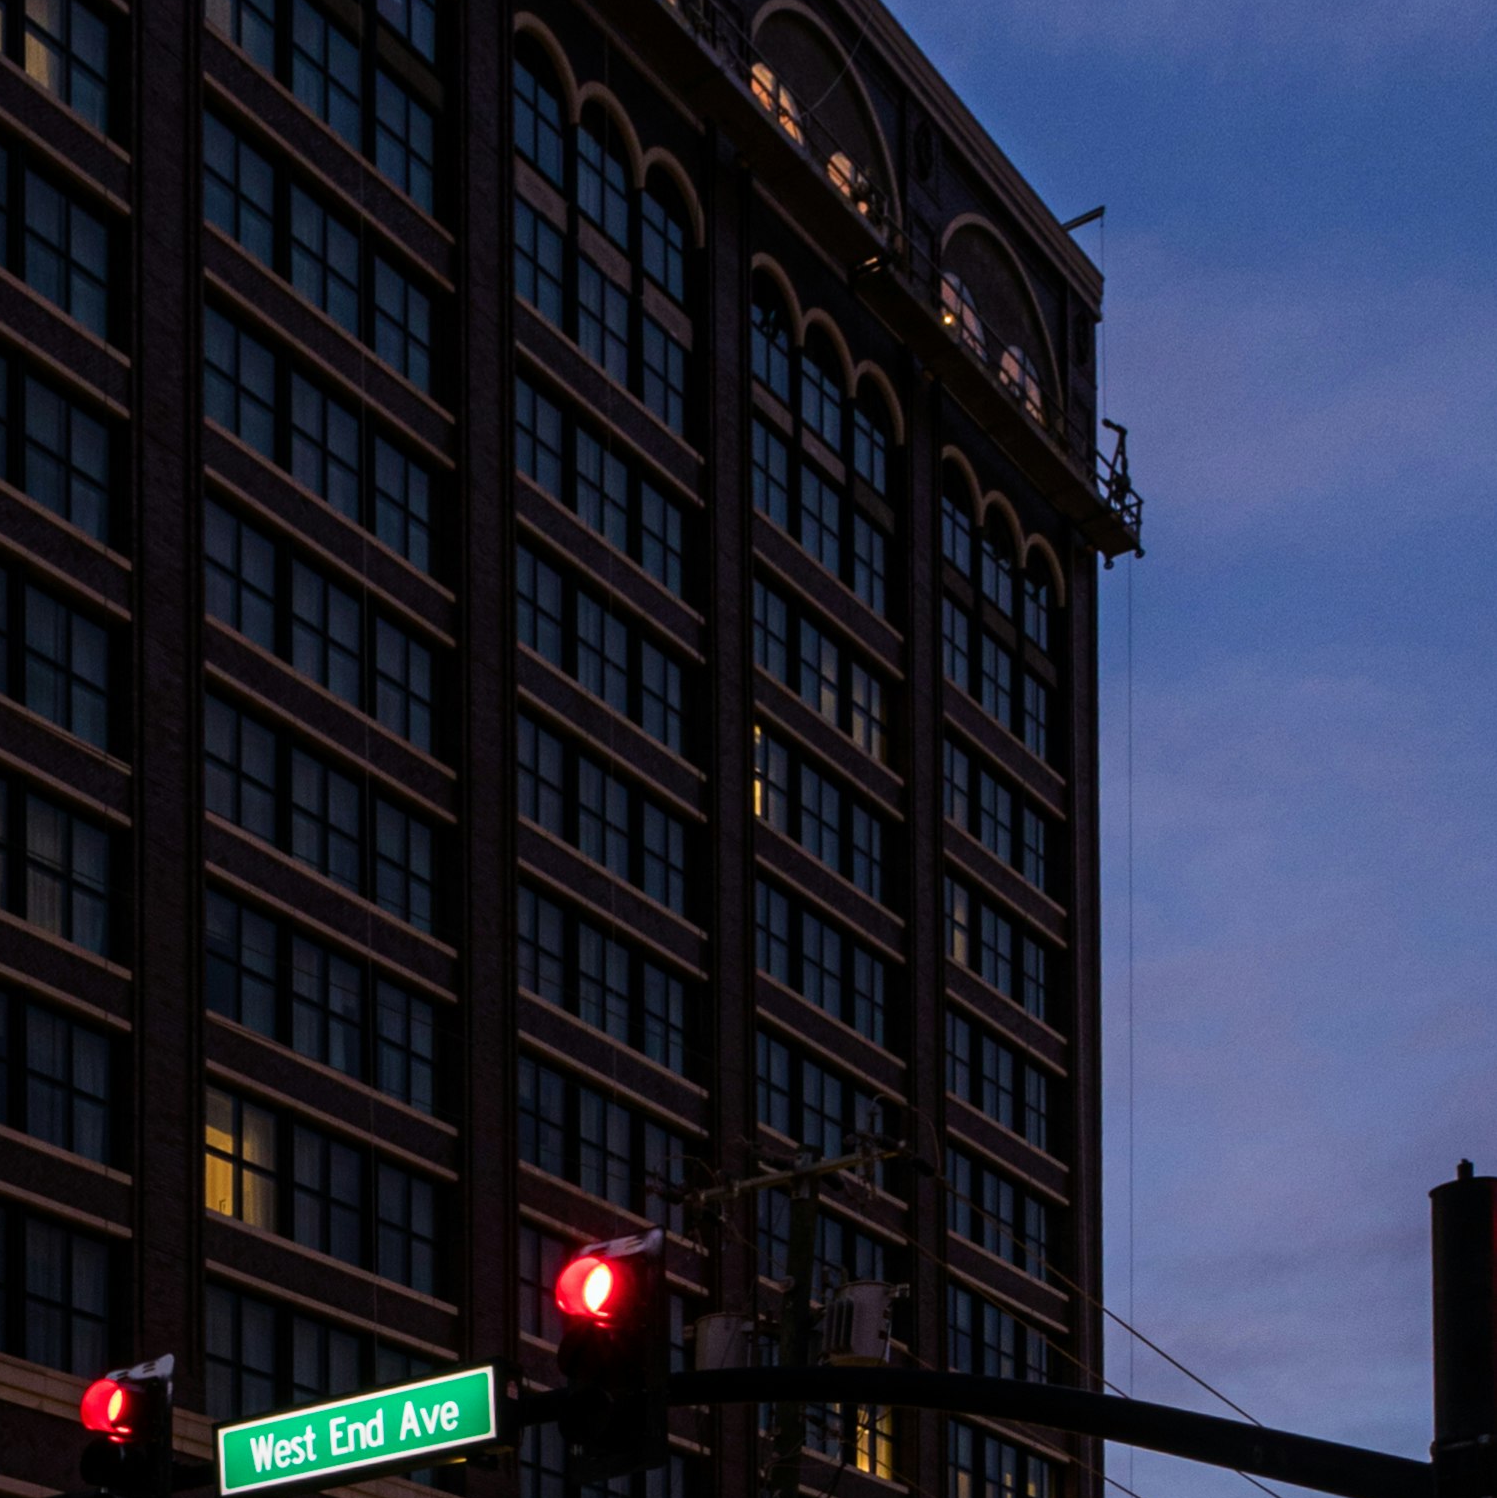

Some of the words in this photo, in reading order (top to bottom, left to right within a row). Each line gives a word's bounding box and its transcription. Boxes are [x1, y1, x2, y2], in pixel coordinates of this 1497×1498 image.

[250, 1424, 317, 1473] West
[329, 1408, 384, 1456] End
[400, 1401, 460, 1441] Ave
